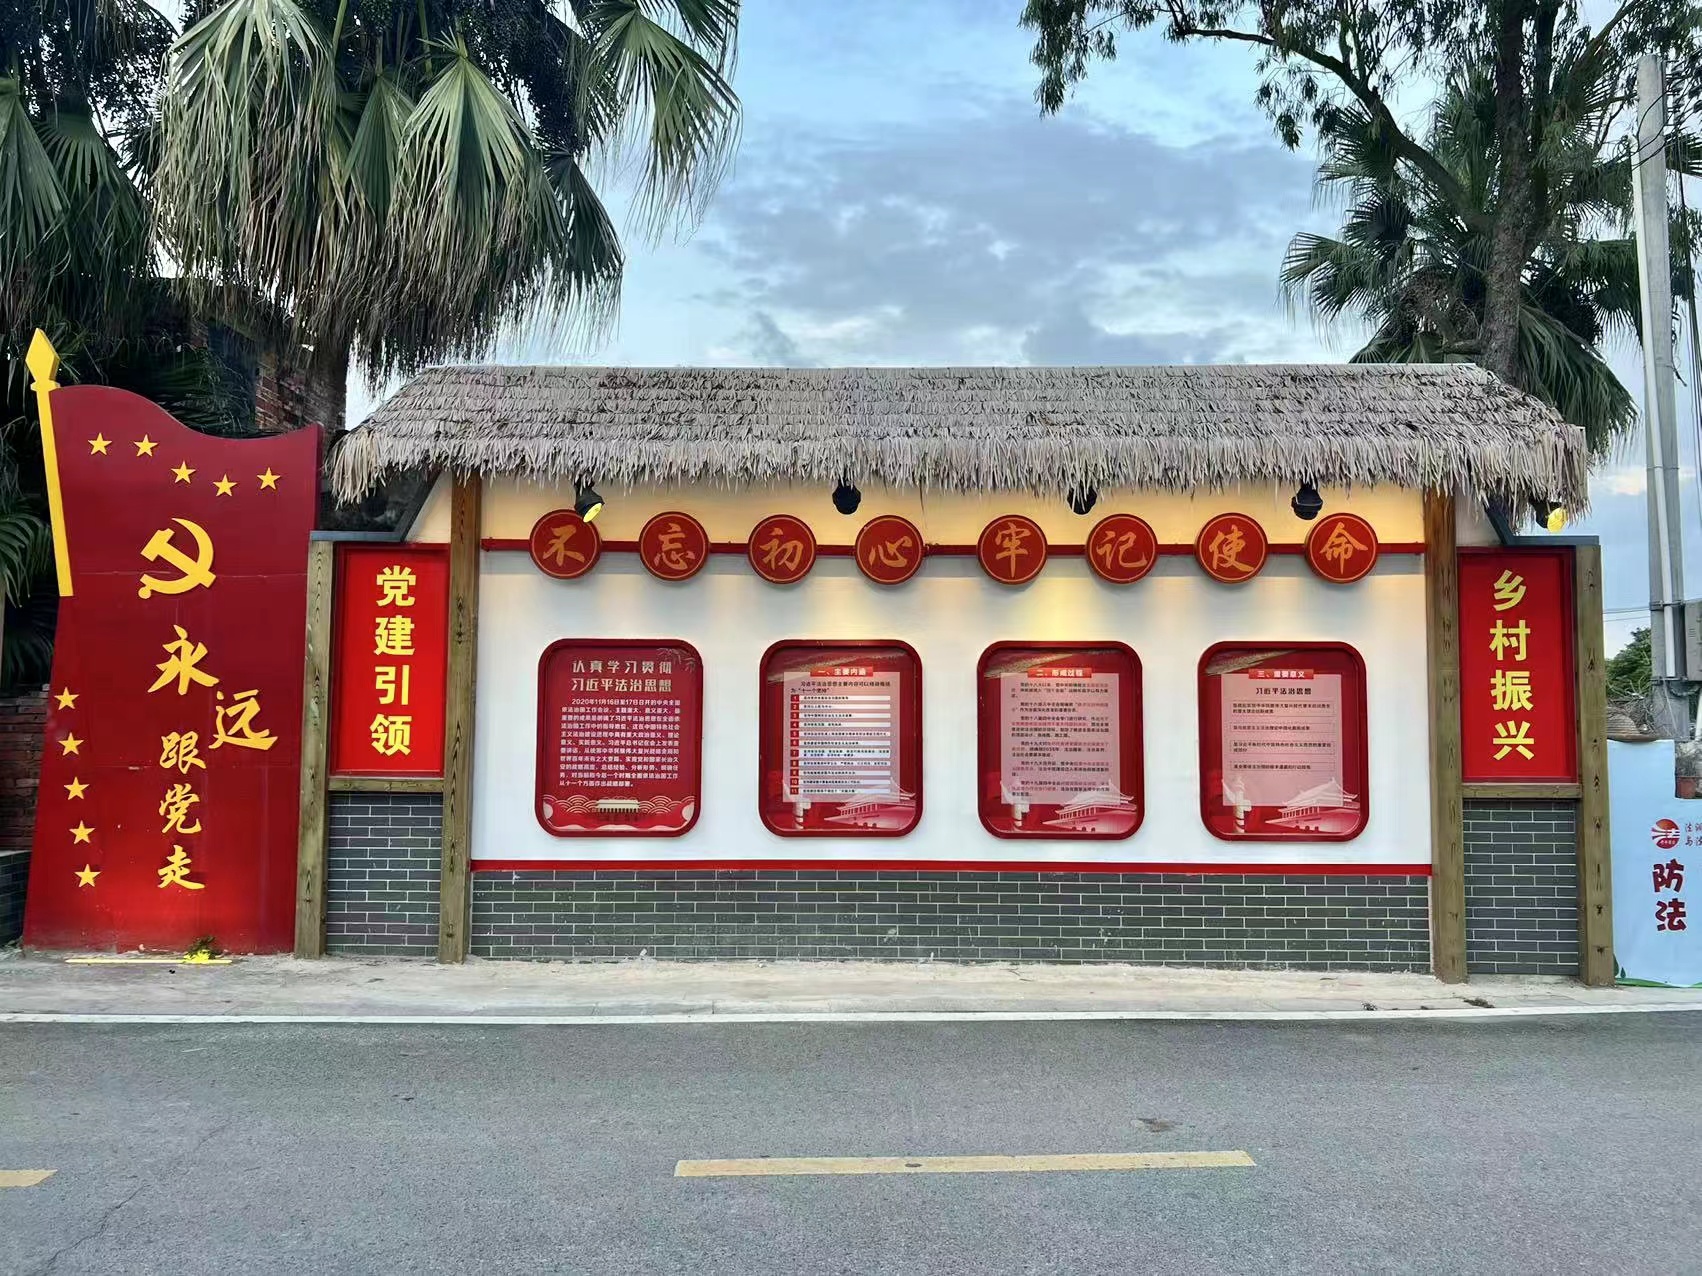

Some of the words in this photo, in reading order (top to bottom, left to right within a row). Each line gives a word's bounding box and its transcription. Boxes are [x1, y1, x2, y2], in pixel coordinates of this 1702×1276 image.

[370, 566, 418, 757] 党建引领
[571, 678, 672, 692] 习近平法治思想
[573, 660, 672, 674] 认真学习贯彻
[1256, 687, 1312, 695] 习近平法治思想
[1489, 569, 1536, 762] 乡村振兴
[148, 624, 279, 891] 永远跟党走
